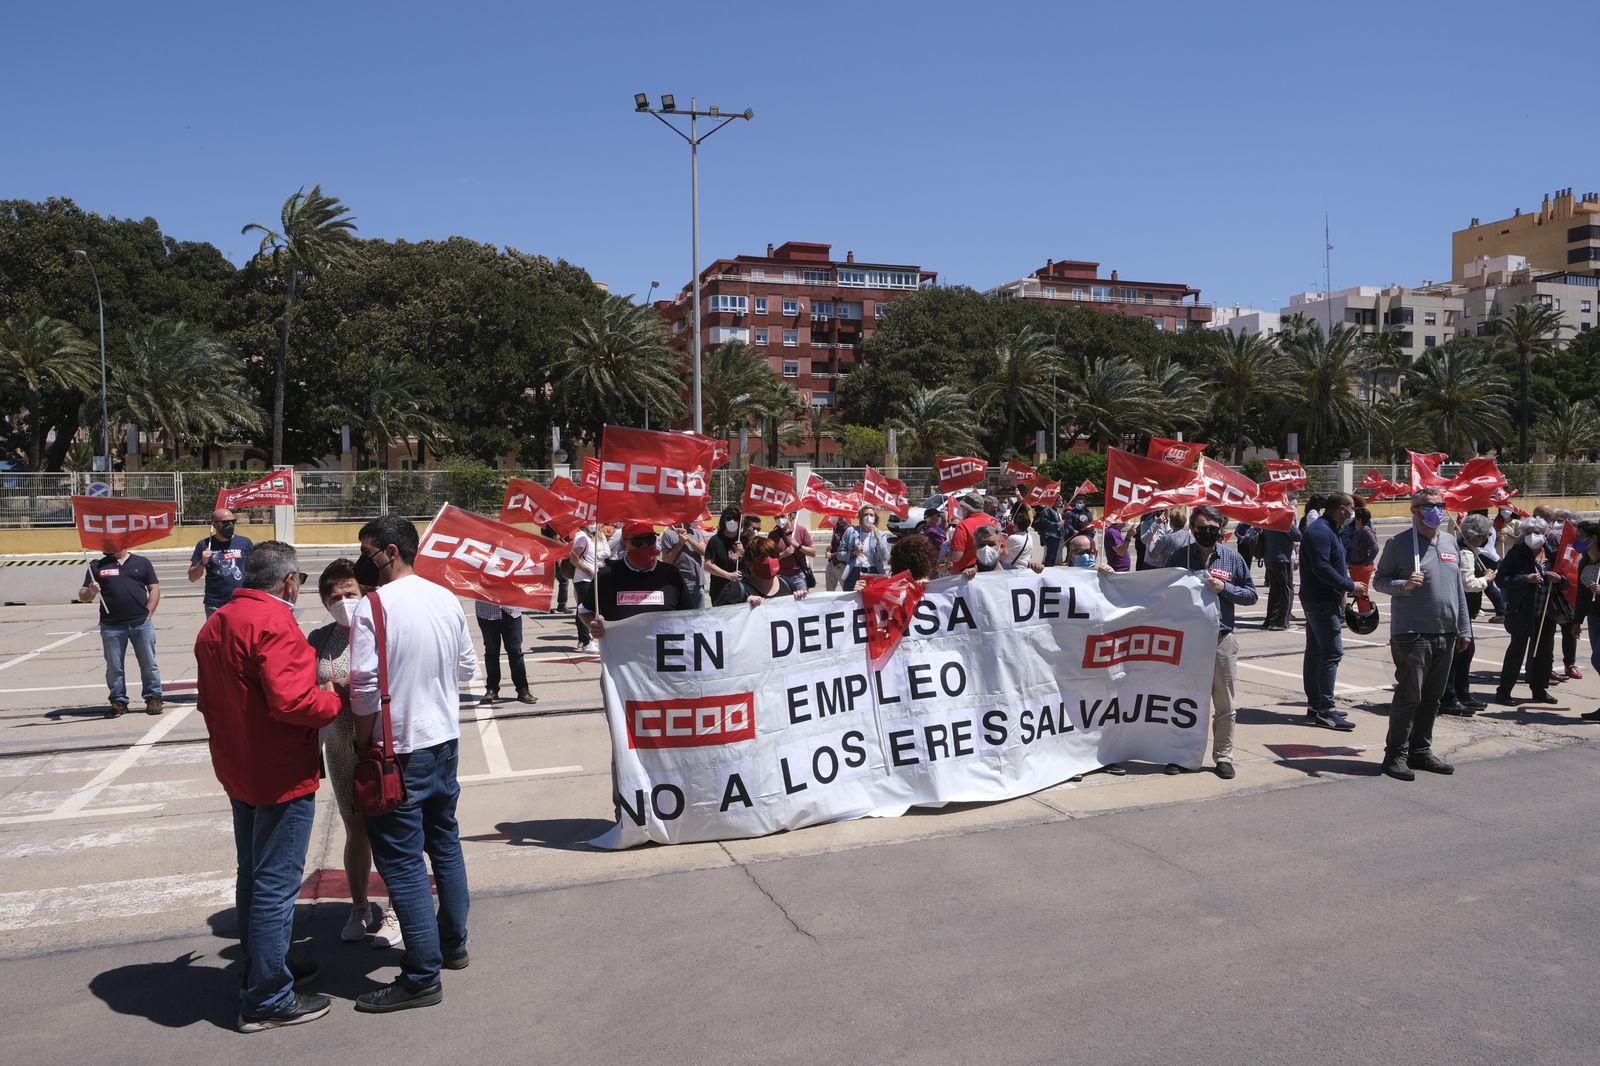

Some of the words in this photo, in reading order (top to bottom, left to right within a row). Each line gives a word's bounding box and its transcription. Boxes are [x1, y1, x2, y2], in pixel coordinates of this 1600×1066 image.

[600, 462, 706, 496] CCOO
[940, 461, 983, 480] CCOO
[83, 512, 169, 534] CCOO
[656, 631, 724, 672] EN
[770, 597, 977, 658] DEFESA
[1011, 586, 1090, 623] DEL
[1092, 633, 1176, 662] CCOO
[787, 661, 967, 725] EMPLEO
[634, 702, 749, 737] CCOO
[618, 784, 686, 829] NO
[719, 773, 753, 812] A
[780, 731, 867, 796] LOS
[889, 710, 1008, 767] ERES
[1019, 693, 1198, 745] SALVAJES
